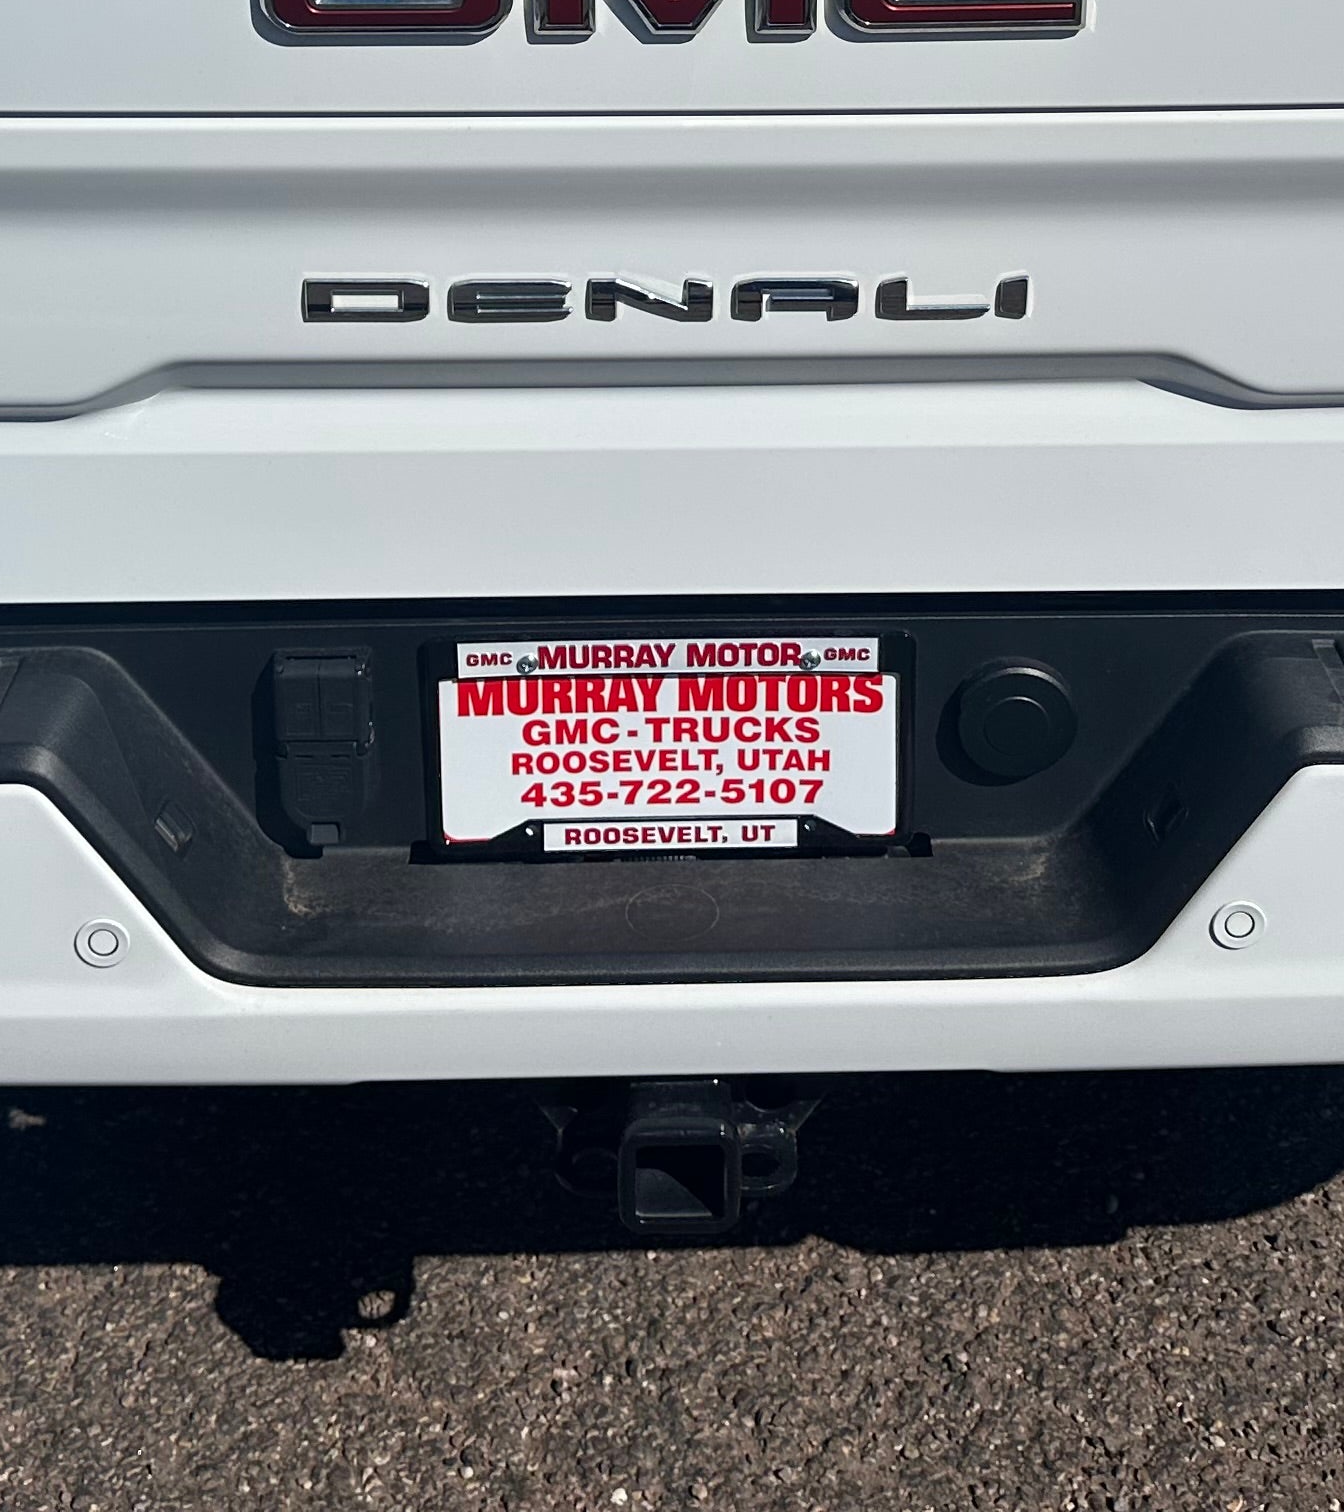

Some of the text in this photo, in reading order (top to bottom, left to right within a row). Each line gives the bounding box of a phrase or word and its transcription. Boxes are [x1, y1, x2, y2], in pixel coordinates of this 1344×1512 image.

[301, 274, 1029, 322] DENALI
[465, 653, 513, 667] GMC
[537, 642, 802, 670] MURRAY MOTOR
[823, 647, 871, 661] GMC
[457, 673, 884, 717] MURRAY MOTORS
[511, 748, 831, 776] ROOSEVELT, UTAH
[520, 778, 824, 808] 435-722-5107
[564, 824, 776, 845] ROOSEVELT, UT
